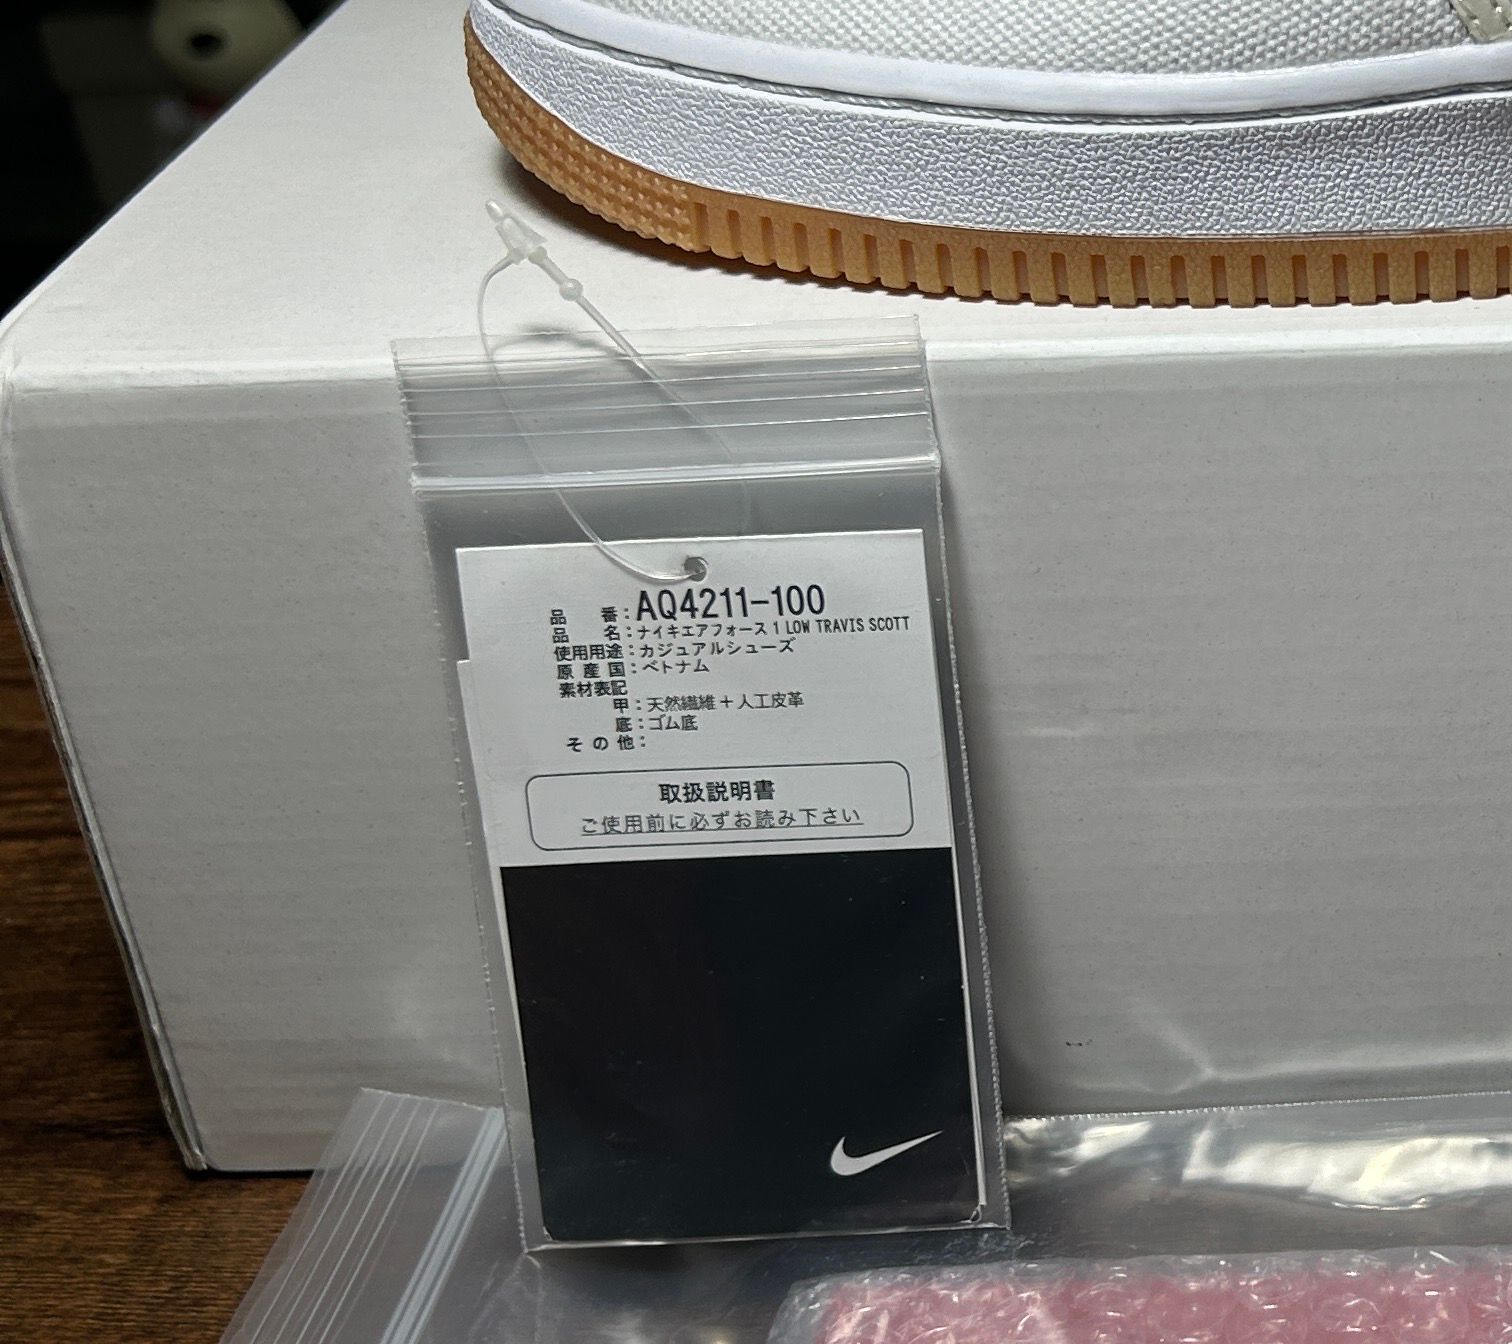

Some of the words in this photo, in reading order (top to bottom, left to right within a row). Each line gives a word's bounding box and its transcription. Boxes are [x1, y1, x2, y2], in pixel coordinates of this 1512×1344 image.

[636, 584, 825, 621] AQ4211-100
[785, 619, 811, 634] LOW
[816, 617, 865, 634] TRAVIS
[868, 616, 910, 632] SCOTT
[559, 680, 628, 698] 素材表記
[658, 779, 776, 804] 取扱説明書
[582, 807, 861, 835] ご使用前に必ずお読み下さい
